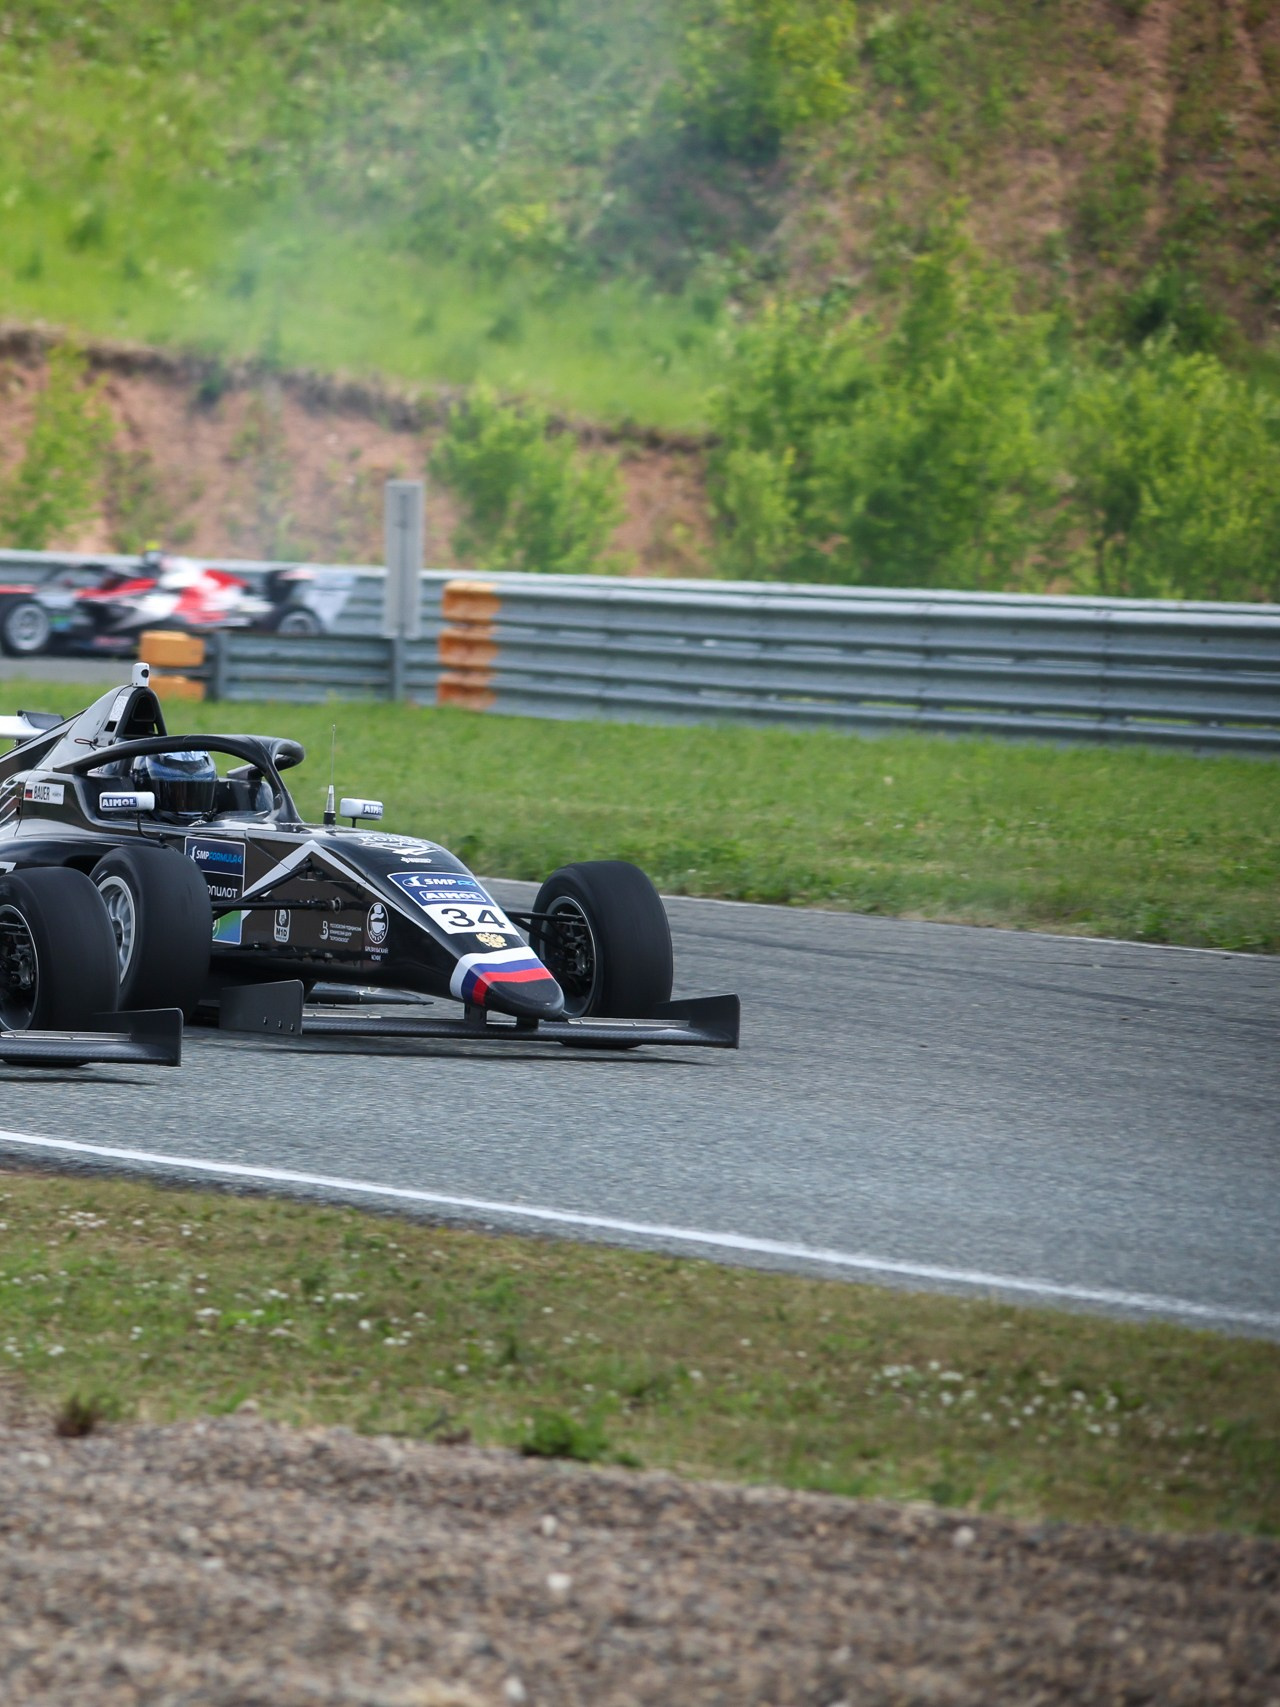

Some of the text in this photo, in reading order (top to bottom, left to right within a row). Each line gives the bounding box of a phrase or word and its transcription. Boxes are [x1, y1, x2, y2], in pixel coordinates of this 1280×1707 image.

[34, 785, 50, 800] BAUER
[102, 797, 137, 808] AIMOL
[425, 891, 482, 900] AIMOL
[441, 907, 505, 929] 34
